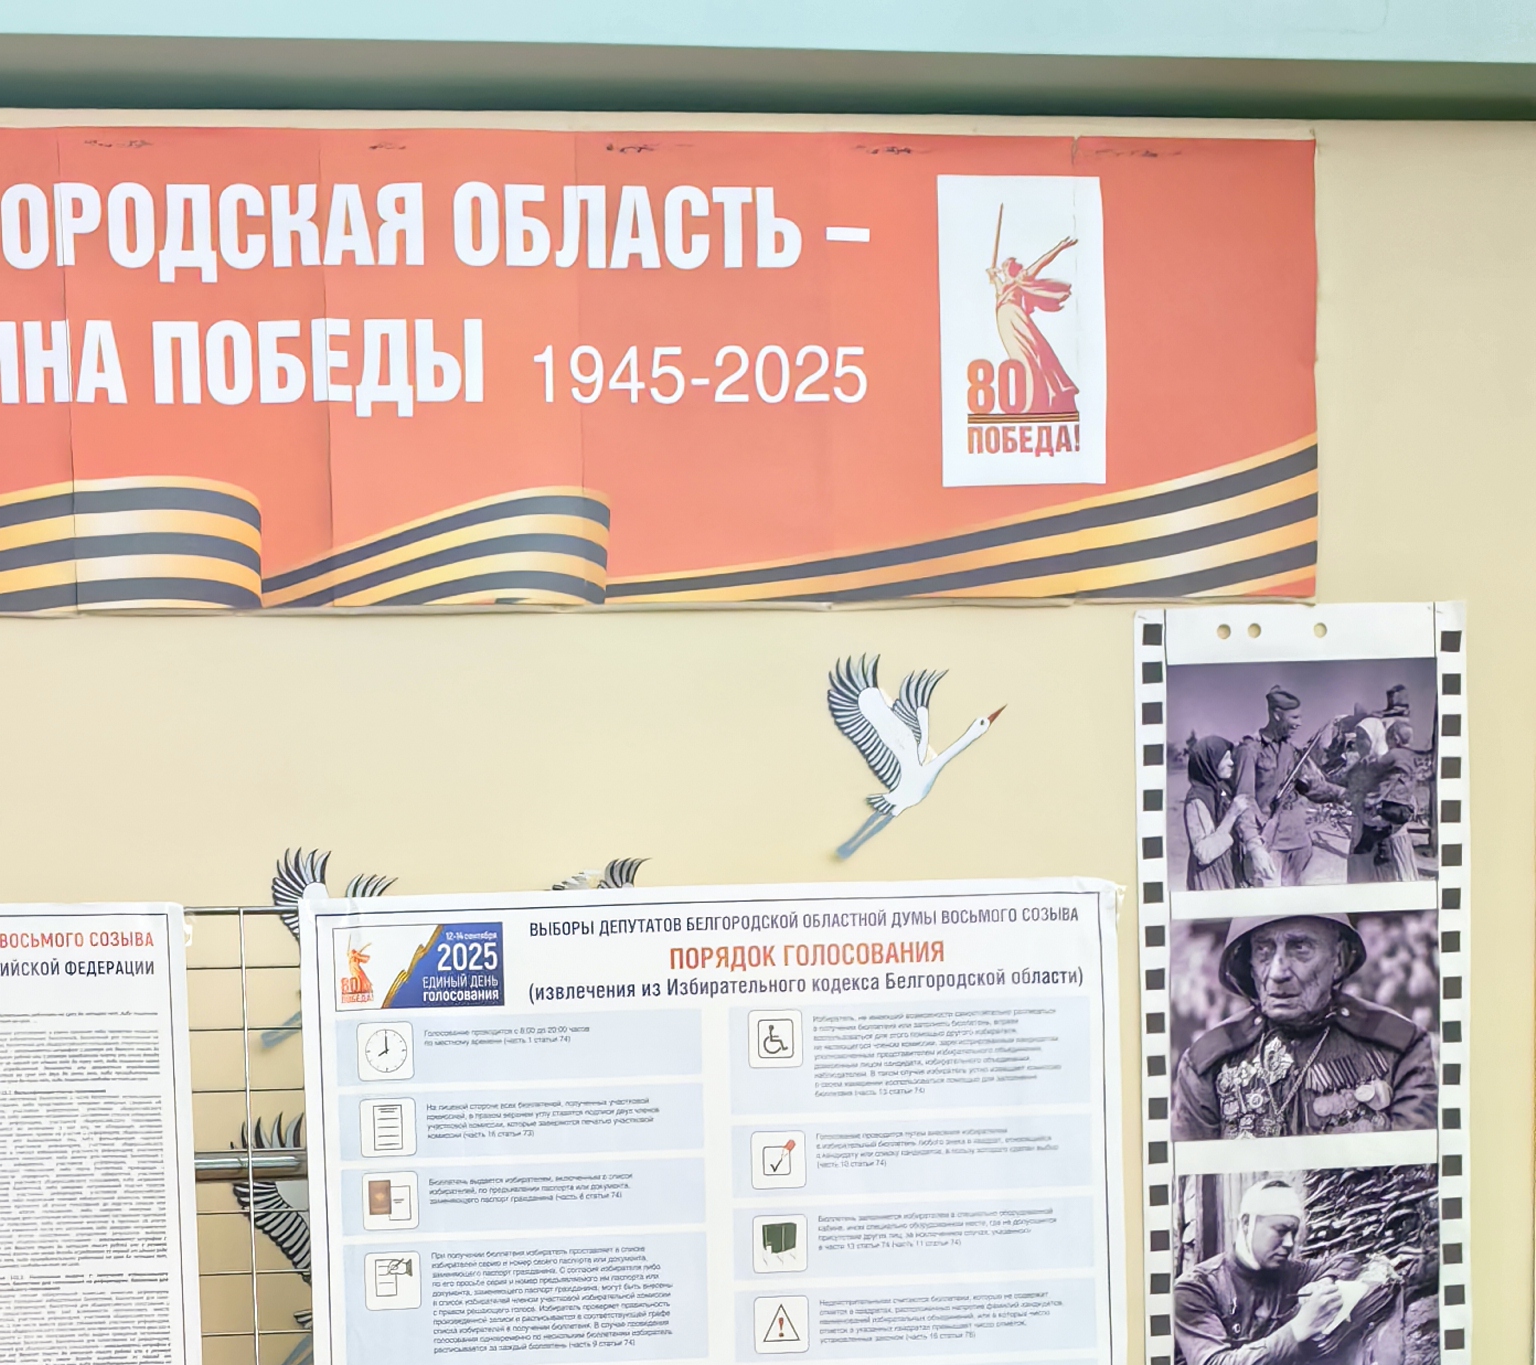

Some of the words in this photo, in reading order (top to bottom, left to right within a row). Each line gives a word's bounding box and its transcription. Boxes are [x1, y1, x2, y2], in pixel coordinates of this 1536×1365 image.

[453, 181, 802, 269] ОБЛАСТЬ
[152, 318, 483, 410] ПОБЕДЫ
[534, 345, 867, 404] 1945-2025
[967, 356, 1027, 419] 80
[968, 421, 1080, 457] ПОБЕДА!
[530, 921, 594, 936] ВЫБОРЫ
[599, 918, 681, 936] ДЕПУТАТОВ
[687, 913, 797, 931] БЕЛГОРОДСКОЙ
[803, 913, 886, 928] ОБЛАСТНОЙ
[891, 911, 936, 928] ДУМЫ
[942, 908, 1016, 924] ВОСЬМОГО
[1023, 907, 1078, 921] СОЗЫВА
[0, 933, 83, 948] ВОСЬМОГО
[90, 931, 154, 947] СОЗЫВА
[65, 961, 154, 977] ФЕДЕРАЦИИ
[438, 942, 498, 971] 2025
[670, 946, 775, 972] ПОРЯДОК
[784, 941, 944, 966] ГОЛОСОВАНИЯ
[423, 974, 467, 989] ЕДИНЫЙ
[470, 976, 498, 988] ДЕНЬ
[529, 983, 635, 1005] (извлечения
[642, 983, 660, 996] из
[668, 978, 805, 998] Избирательного
[813, 977, 879, 994] кодекса
[886, 969, 1005, 991] Белгородской
[1012, 967, 1083, 986] области)
